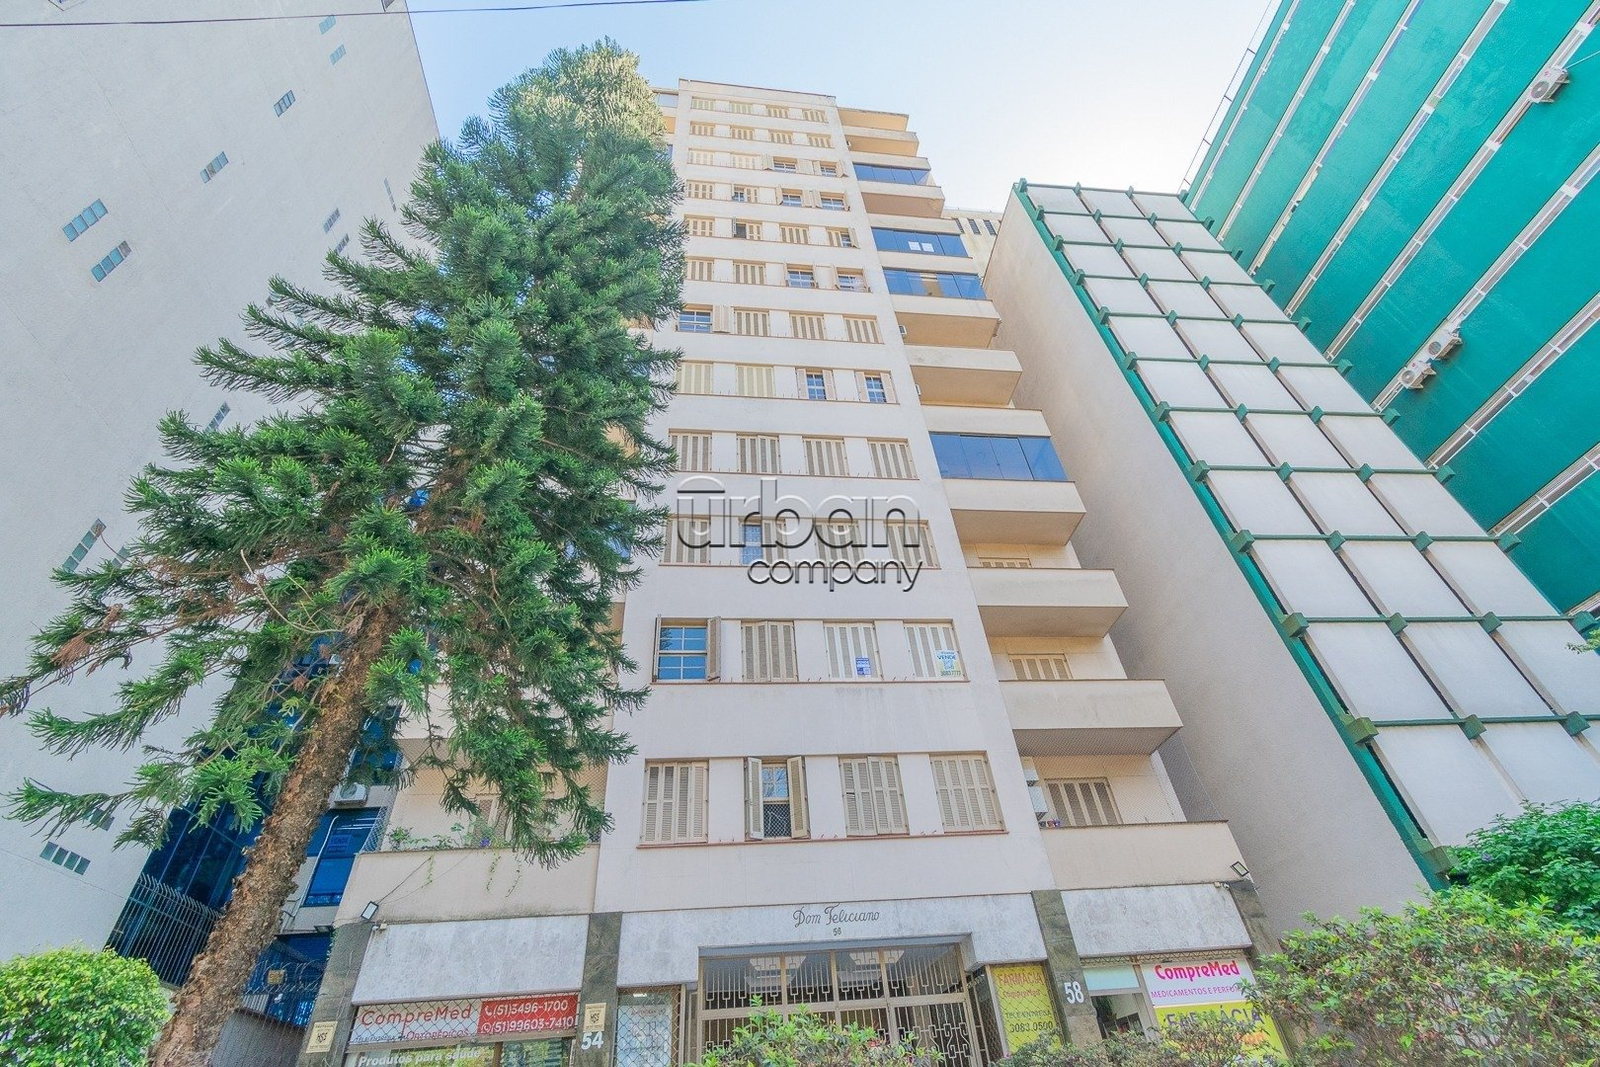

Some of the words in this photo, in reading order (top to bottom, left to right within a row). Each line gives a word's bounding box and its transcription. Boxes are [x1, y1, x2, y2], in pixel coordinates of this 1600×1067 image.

[793, 906, 822, 928] Dom
[824, 902, 880, 926] Feliciano
[1154, 960, 1241, 981] CompreMed
[1063, 981, 1085, 1005] 58
[1150, 987, 1207, 999] MEDICAMENTOS
[361, 1004, 472, 1037] CompreMed
[1009, 1020, 1054, 1033] 3083.0500
[580, 1031, 604, 1050] 54
[358, 1052, 412, 1067] Produtos
[415, 1053, 443, 1064] para
